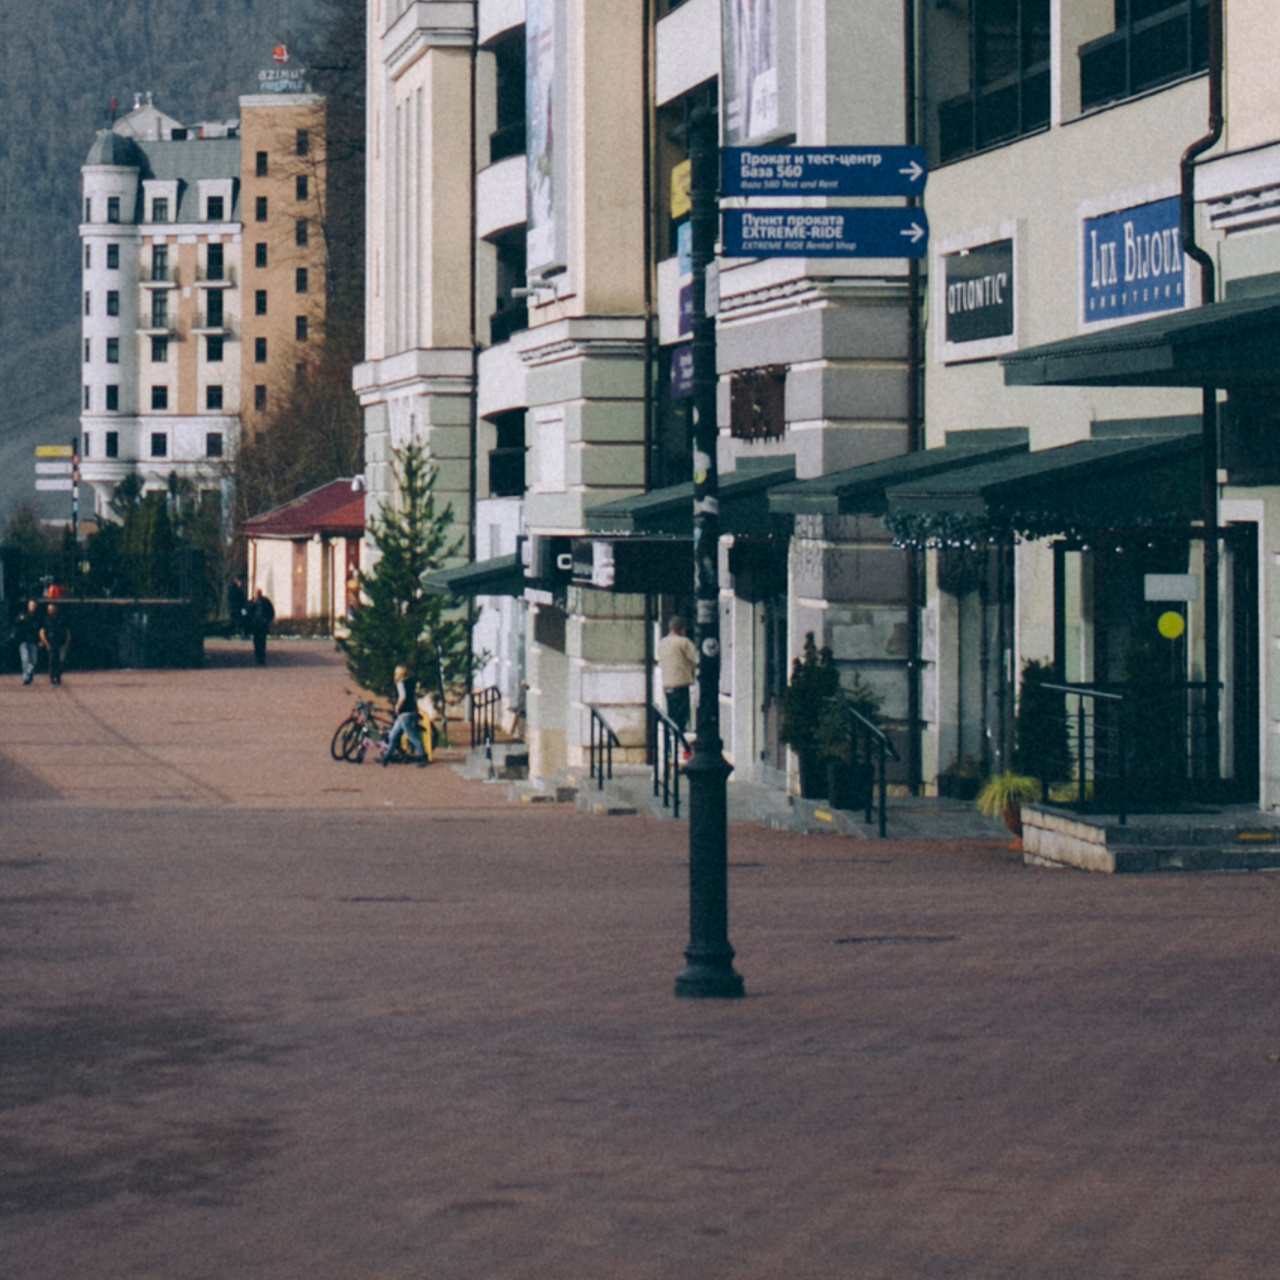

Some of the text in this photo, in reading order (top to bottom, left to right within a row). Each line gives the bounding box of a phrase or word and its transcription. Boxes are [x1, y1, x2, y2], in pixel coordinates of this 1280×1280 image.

[740, 152, 882, 167] Прокат и тест-центр
[740, 165, 803, 178] База 560
[742, 213, 845, 228] Пункт проката
[742, 226, 843, 239] EXTREME-RIDE
[742, 241, 783, 250] EXTREME
